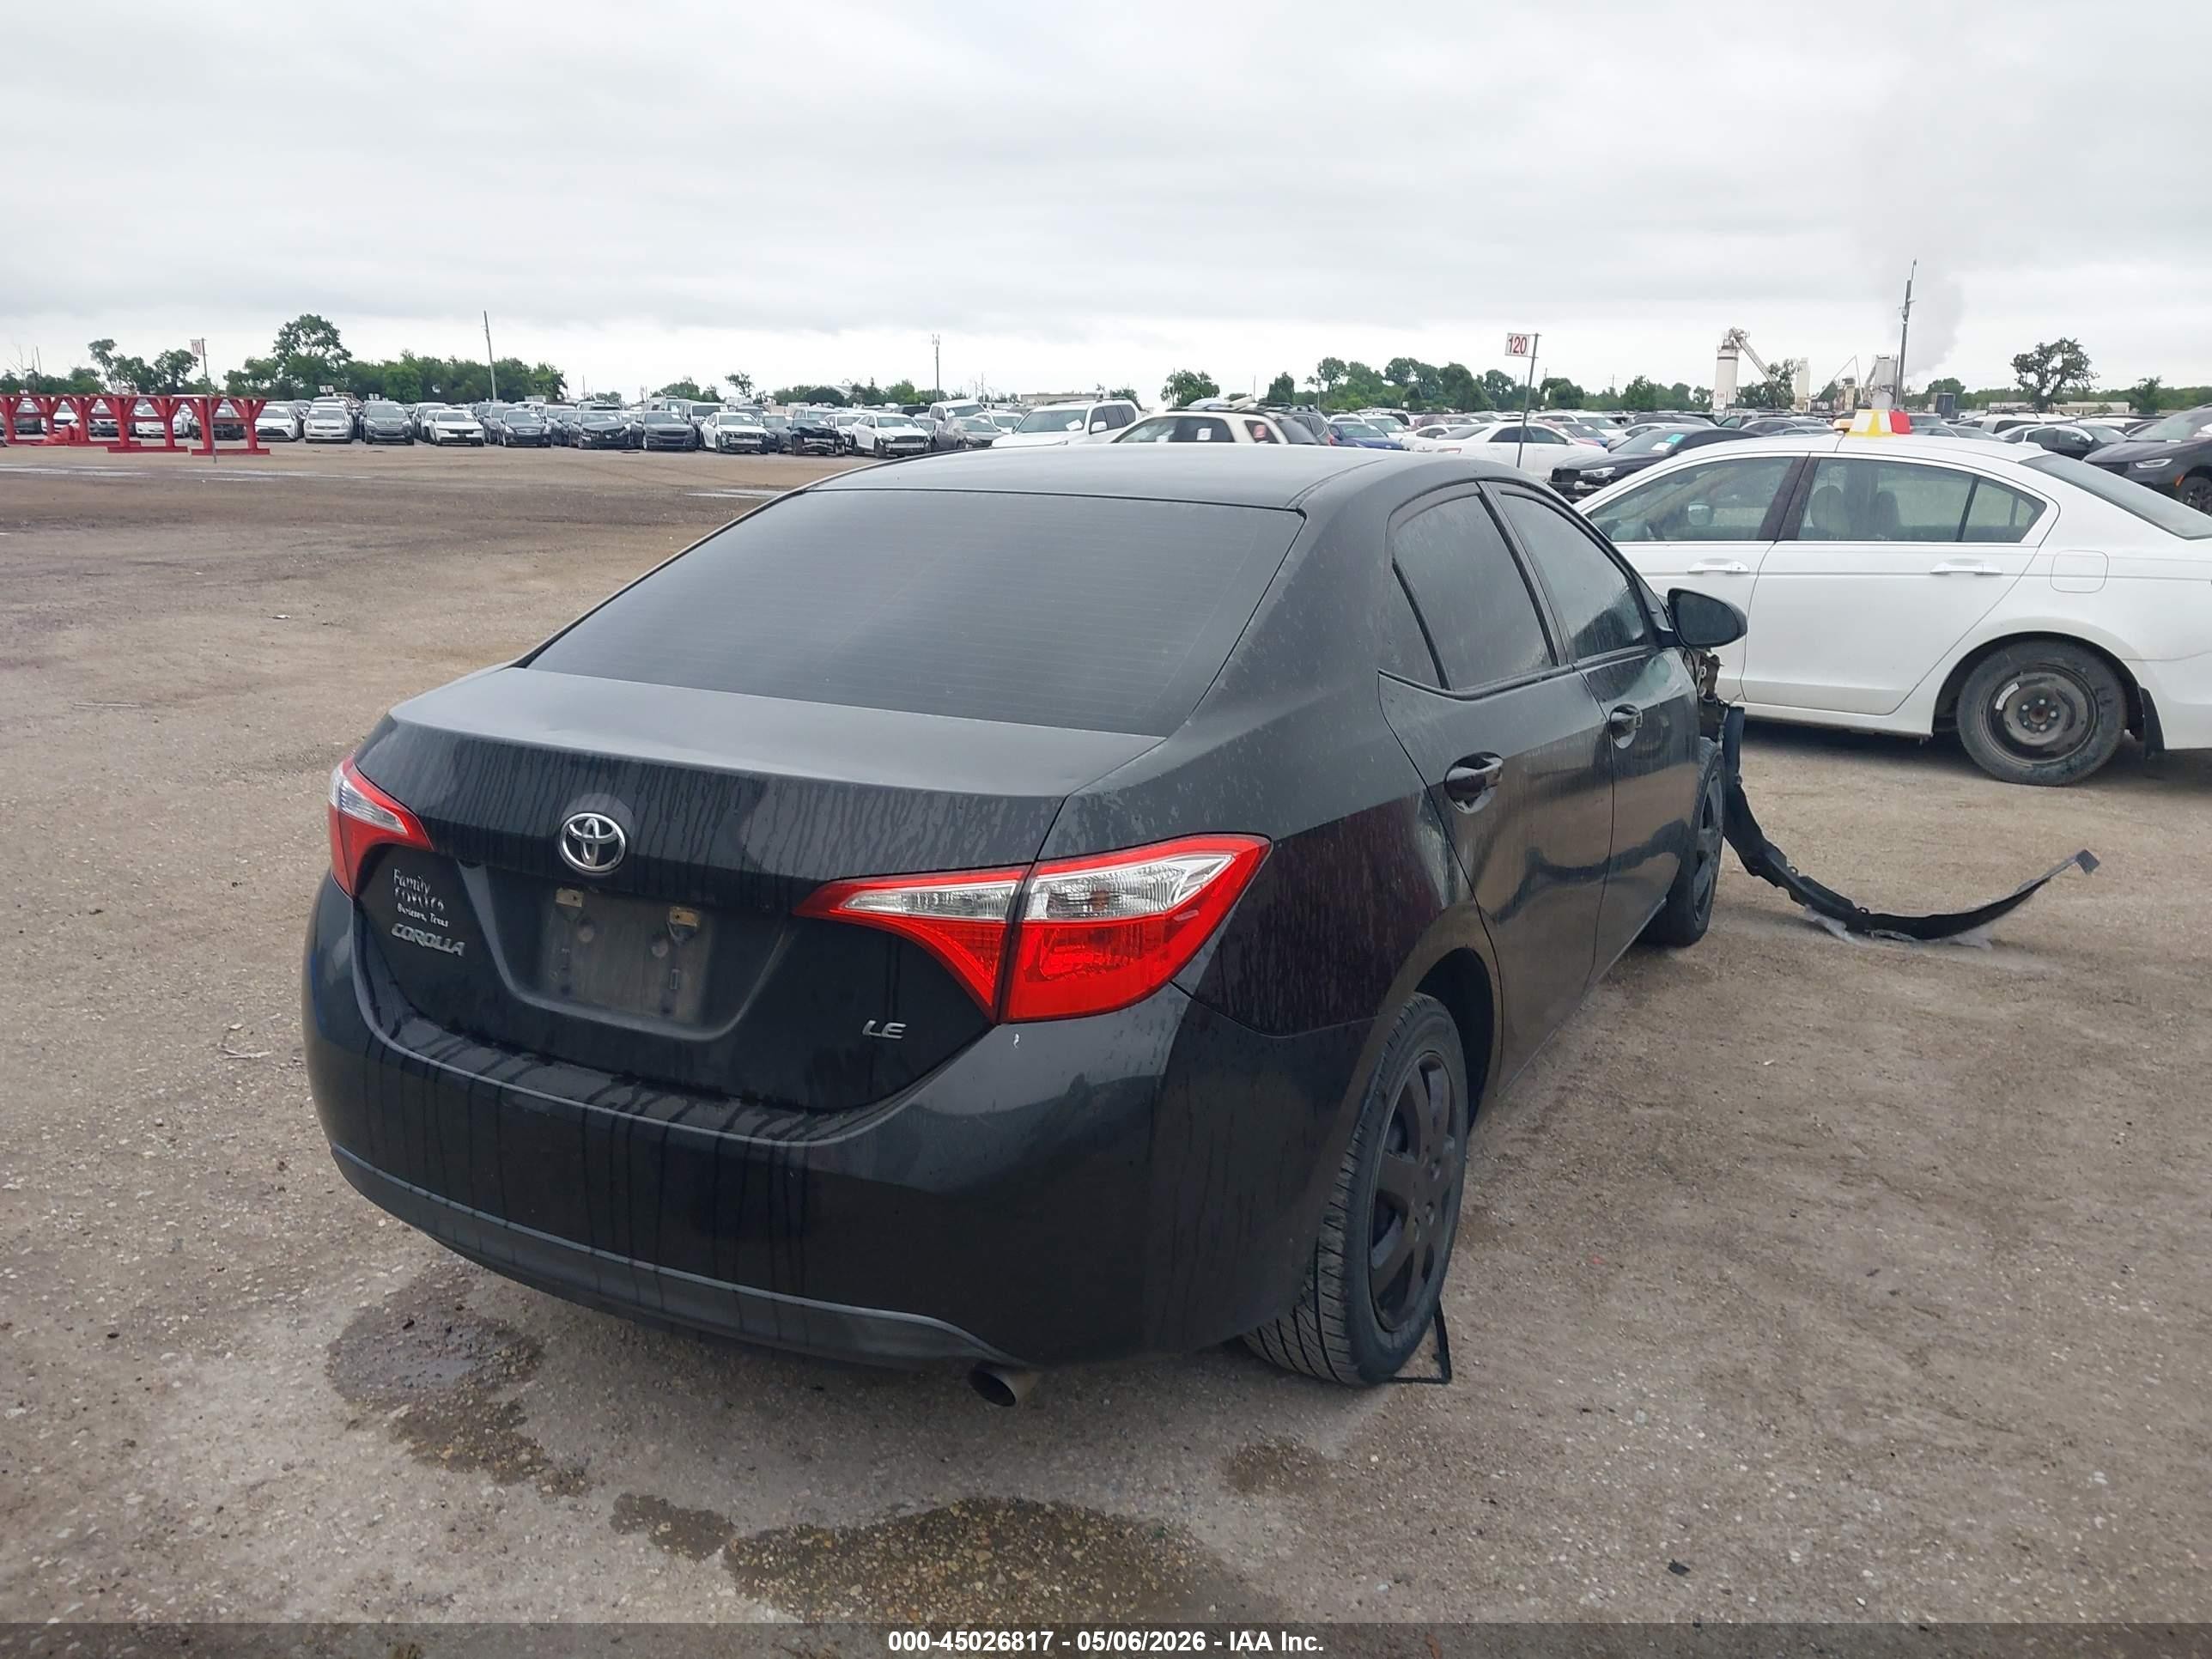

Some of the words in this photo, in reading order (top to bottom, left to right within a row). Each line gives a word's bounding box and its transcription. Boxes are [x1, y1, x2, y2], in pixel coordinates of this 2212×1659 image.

[1509, 336, 1528, 355] 120
[393, 868, 430, 895] Family
[429, 912, 449, 927] Texas
[392, 923, 465, 956] COROLLA
[862, 1019, 907, 1039] LE
